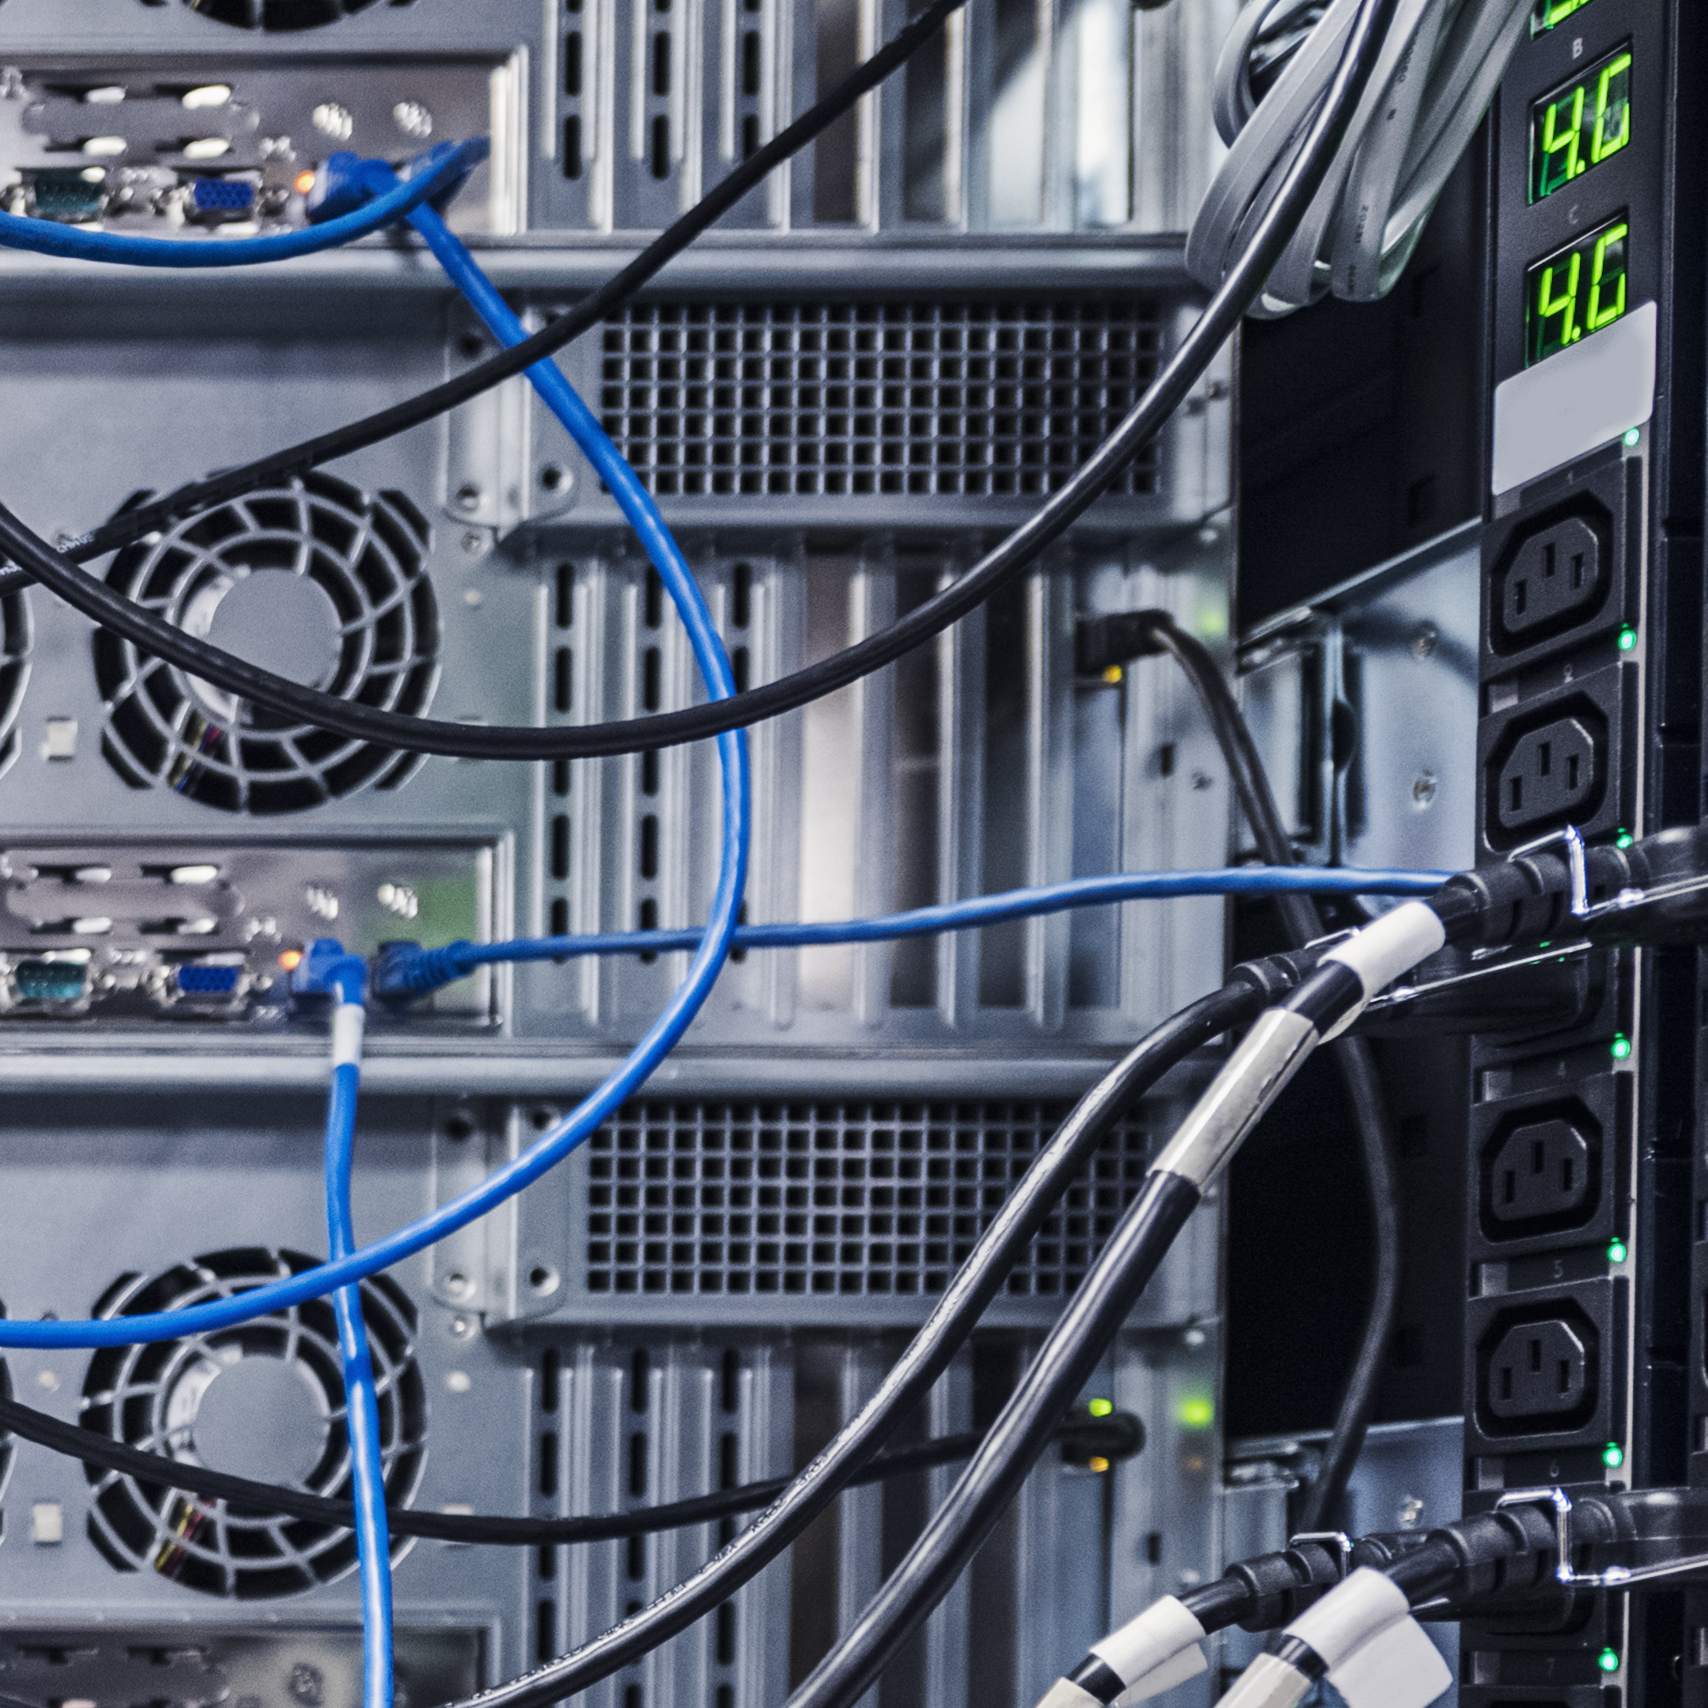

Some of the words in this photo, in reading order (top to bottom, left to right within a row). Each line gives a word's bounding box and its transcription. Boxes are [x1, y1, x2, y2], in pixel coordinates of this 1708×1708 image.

[1572, 37, 1583, 59] B
[1553, 1258, 1564, 1279] 5
[1549, 1458, 1559, 1478] 6
